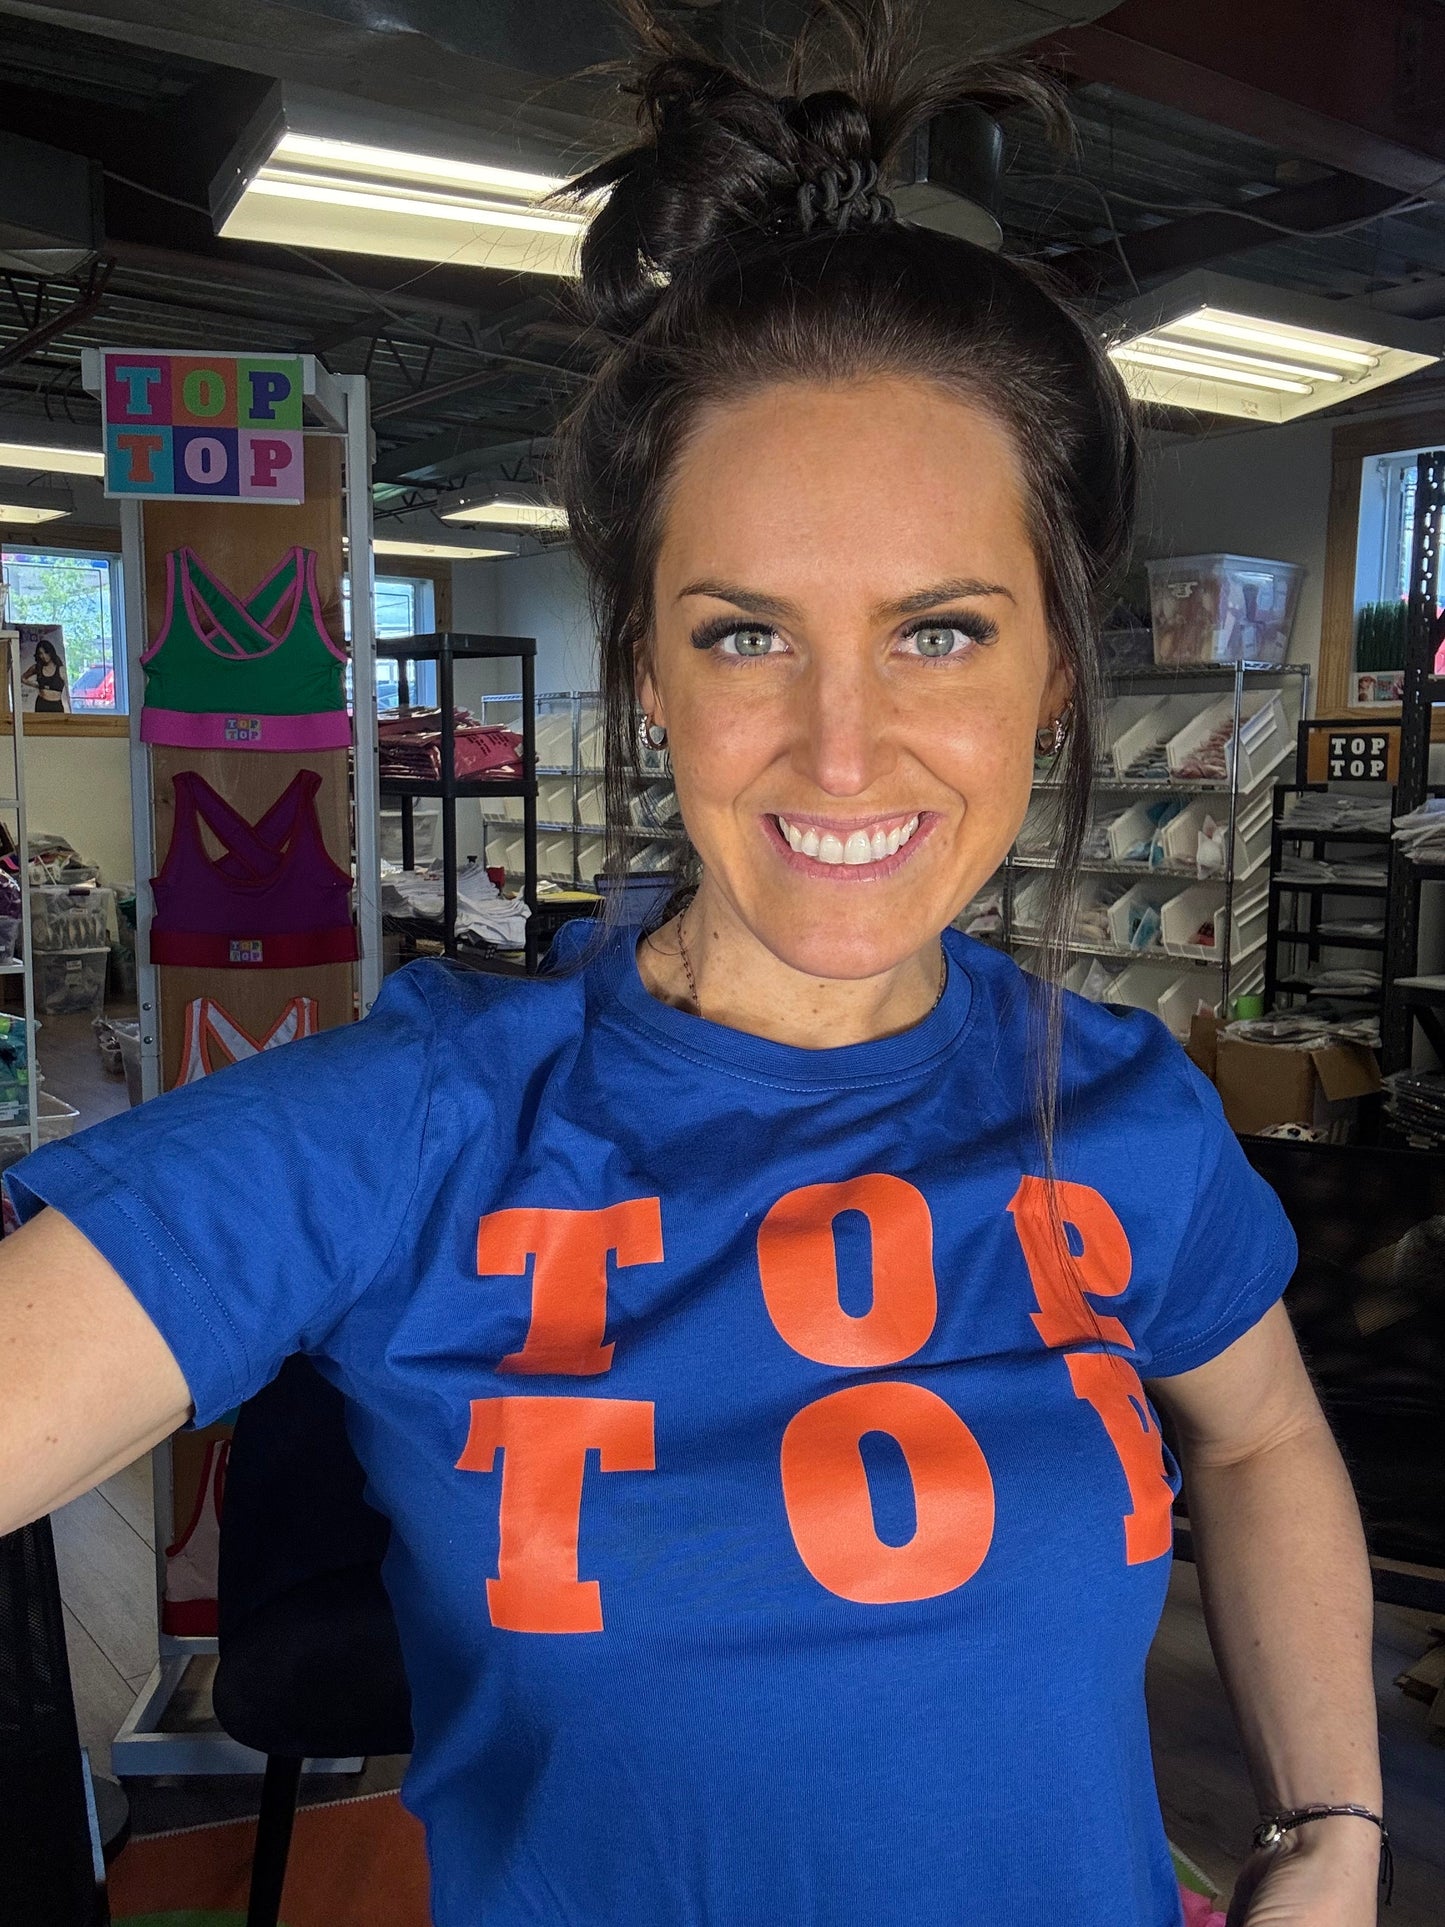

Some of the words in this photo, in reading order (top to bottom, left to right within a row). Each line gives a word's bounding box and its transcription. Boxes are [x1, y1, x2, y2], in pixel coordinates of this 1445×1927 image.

[115, 366, 292, 419] TOP
[117, 434, 293, 487] TOP
[227, 719, 260, 729] TOP
[227, 730, 260, 740] TOP
[1331, 738, 1386, 755] TOP
[1330, 760, 1385, 777] TOP
[477, 1173, 1135, 1375] TOP
